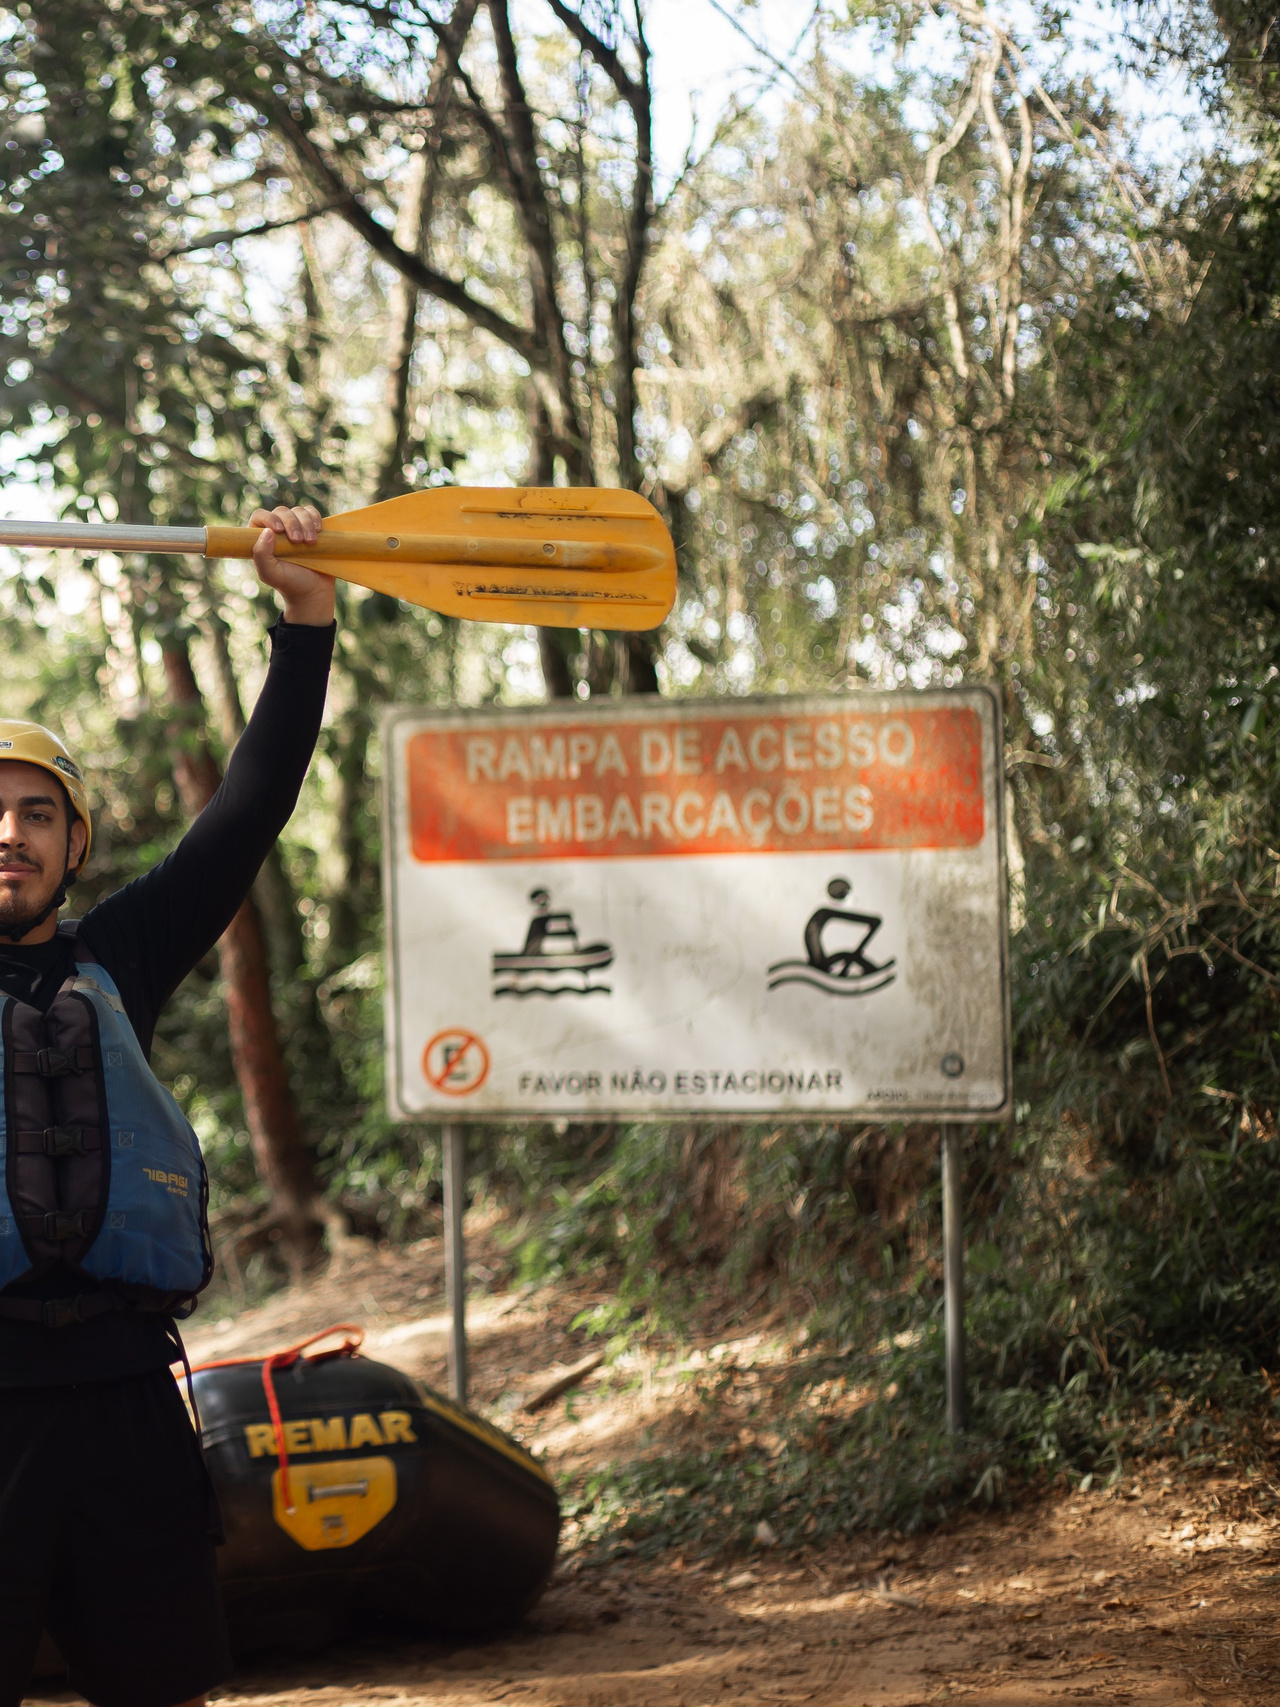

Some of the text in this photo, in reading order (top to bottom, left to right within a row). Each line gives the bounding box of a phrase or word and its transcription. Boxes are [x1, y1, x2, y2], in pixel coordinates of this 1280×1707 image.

[466, 721, 916, 782] RAMPA DE ACESSO
[506, 780, 875, 847] EMBARCAÇÕES
[520, 1064, 844, 1096] FAVOR NÃO ESTACIONAR
[142, 1167, 188, 1189] TIBAGI
[244, 1410, 418, 1458] REMAR
